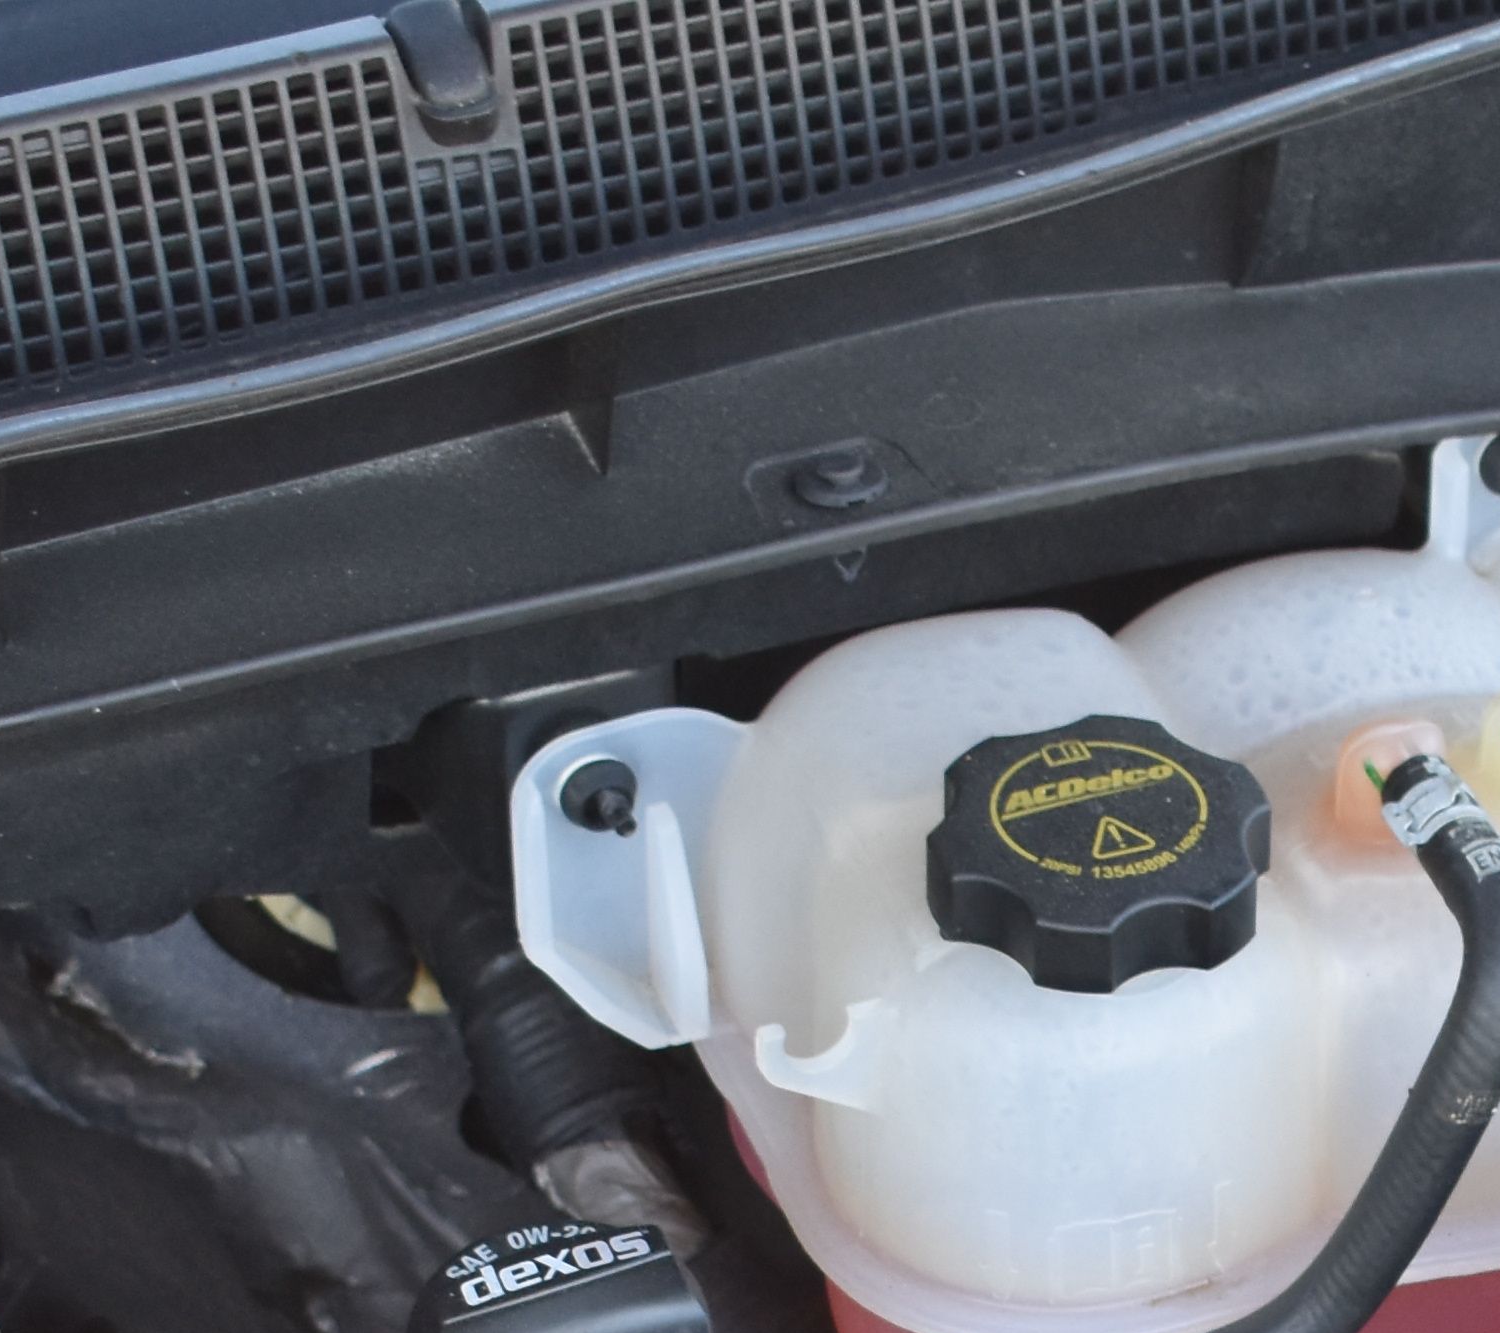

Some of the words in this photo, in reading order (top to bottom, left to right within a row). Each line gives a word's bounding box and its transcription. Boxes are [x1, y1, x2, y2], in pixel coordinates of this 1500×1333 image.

[1005, 763, 1175, 813] ACDelco
[445, 1241, 498, 1280] SAE
[460, 1230, 651, 1308] dexos
